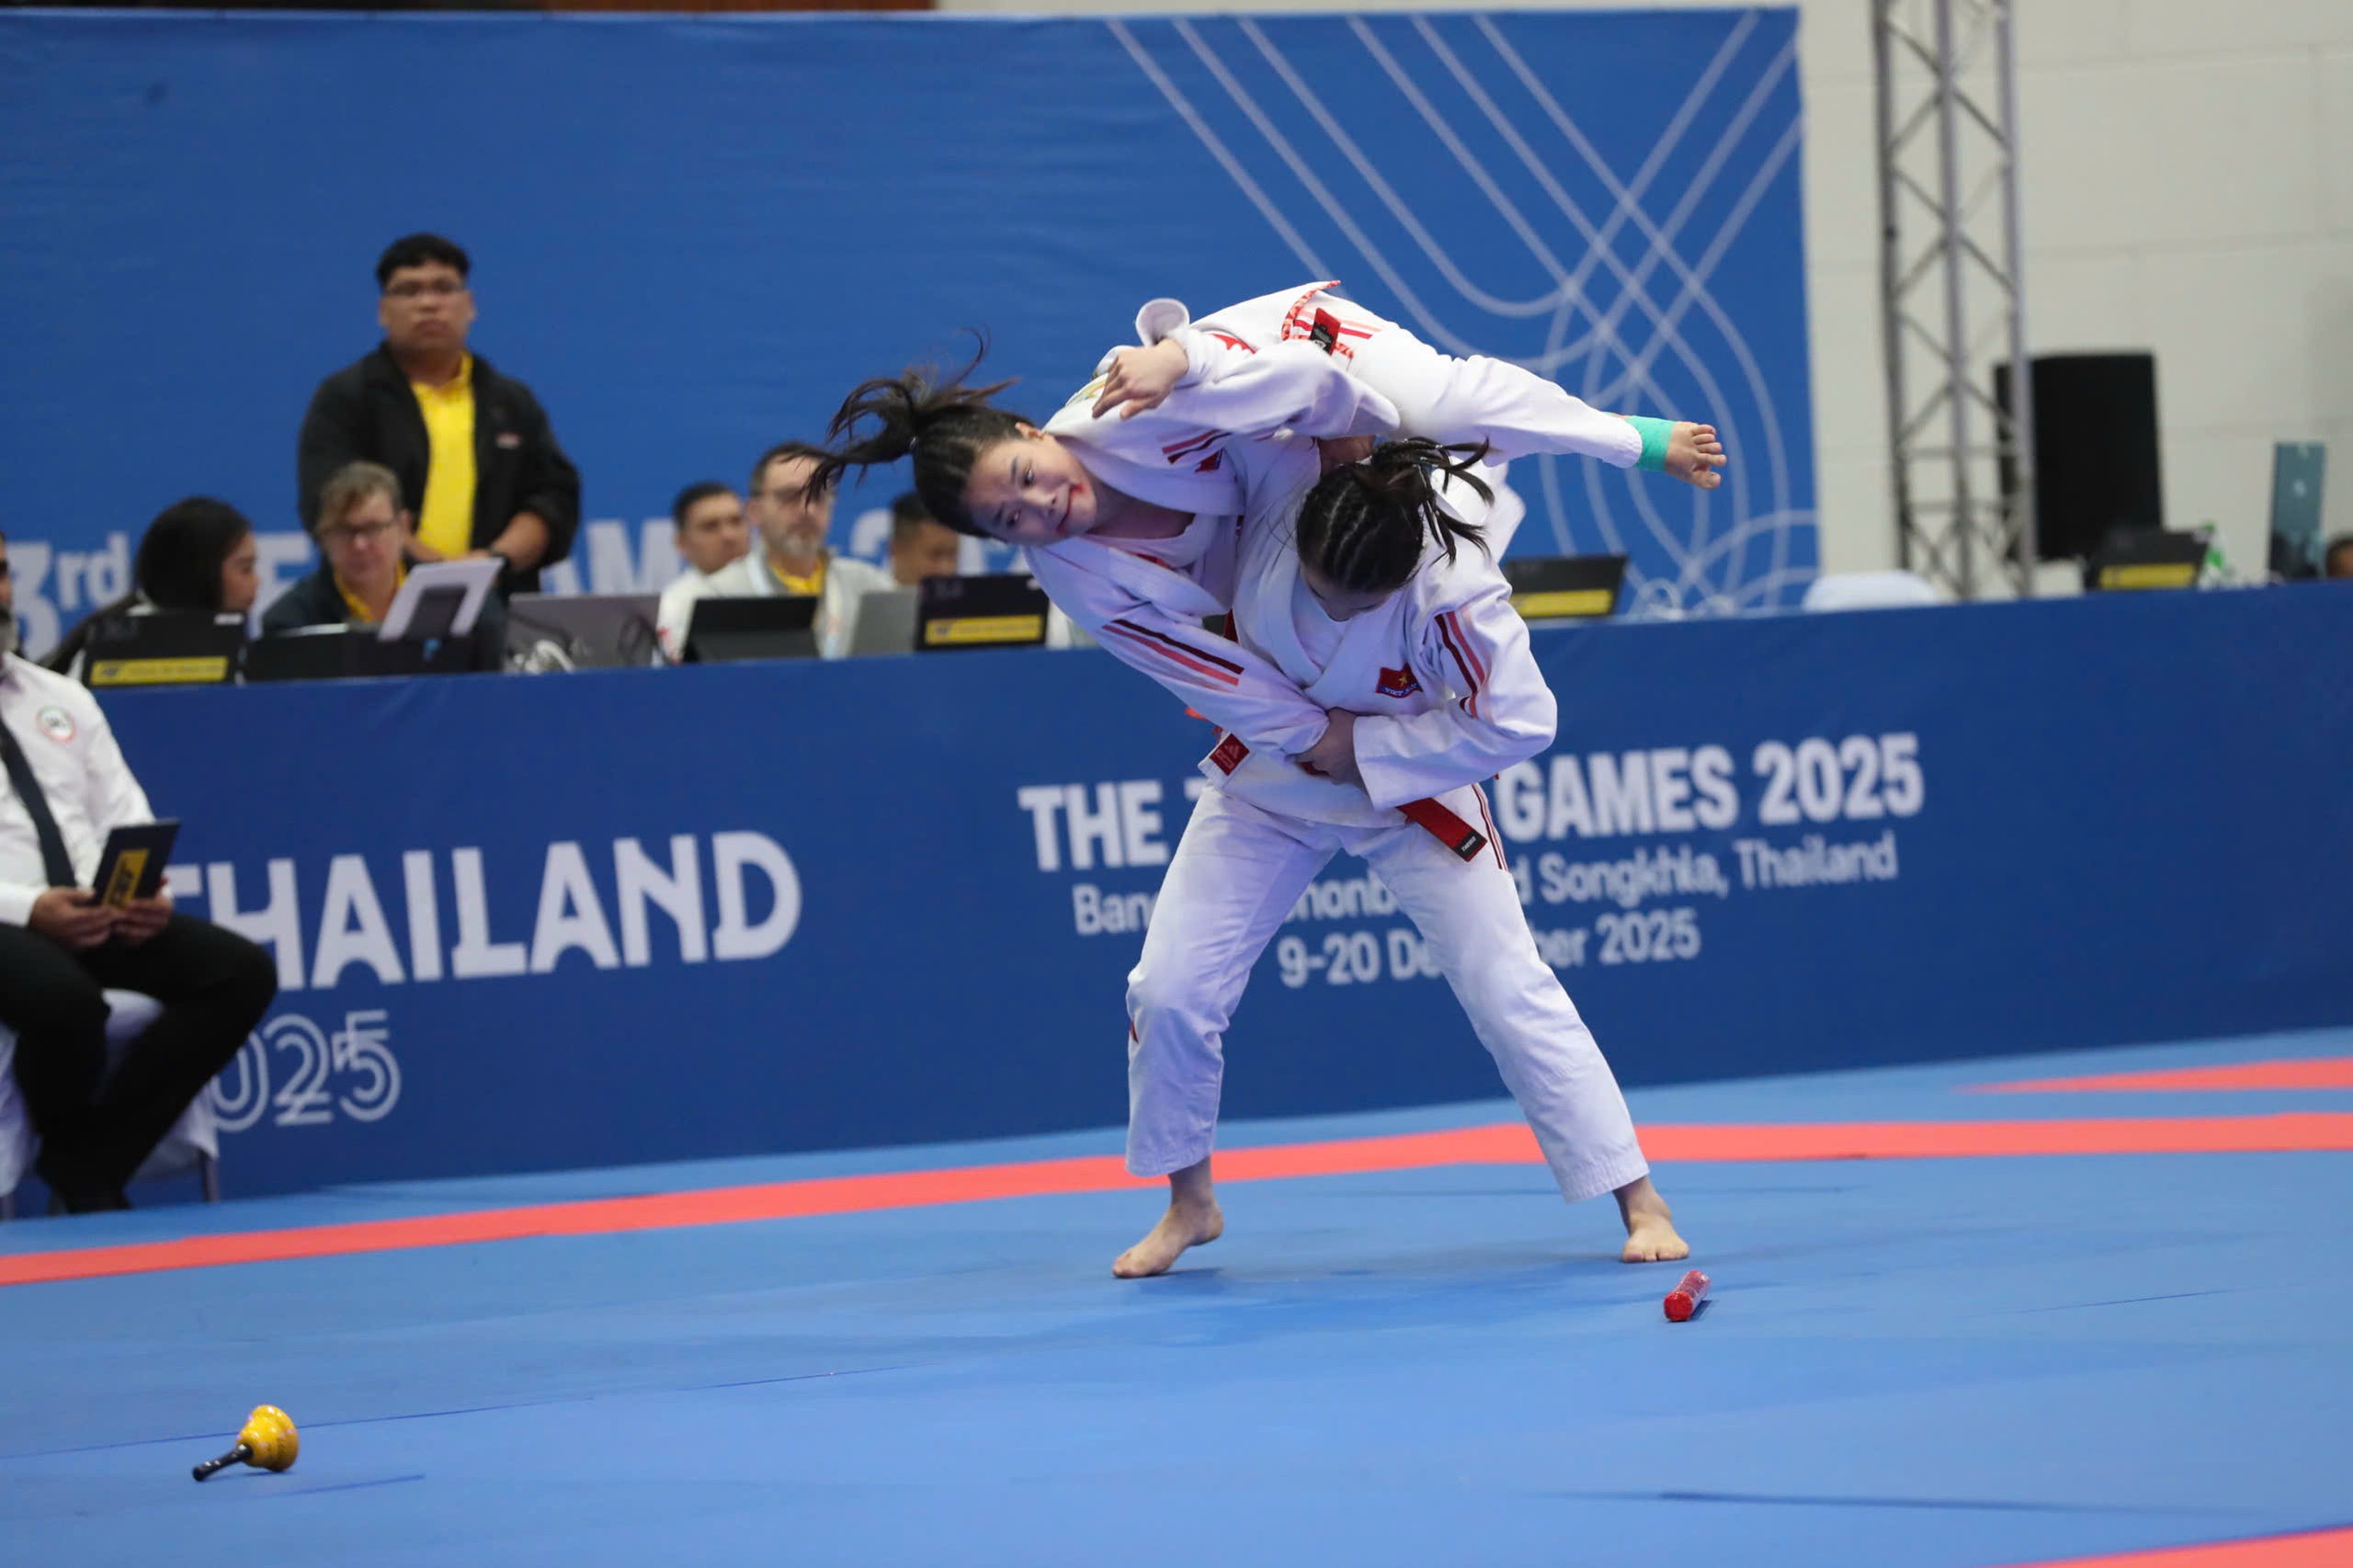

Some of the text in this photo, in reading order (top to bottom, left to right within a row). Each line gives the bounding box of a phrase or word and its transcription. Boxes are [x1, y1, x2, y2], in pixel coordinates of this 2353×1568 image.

[1018, 732, 1925, 871] THE GAMES 2025
[1733, 828, 1899, 890] Thailand
[164, 830, 801, 991] HAILAND
[1278, 931, 1381, 988] 9-20
[1596, 907, 1701, 966] 2025
[210, 1009, 403, 1132] 025
